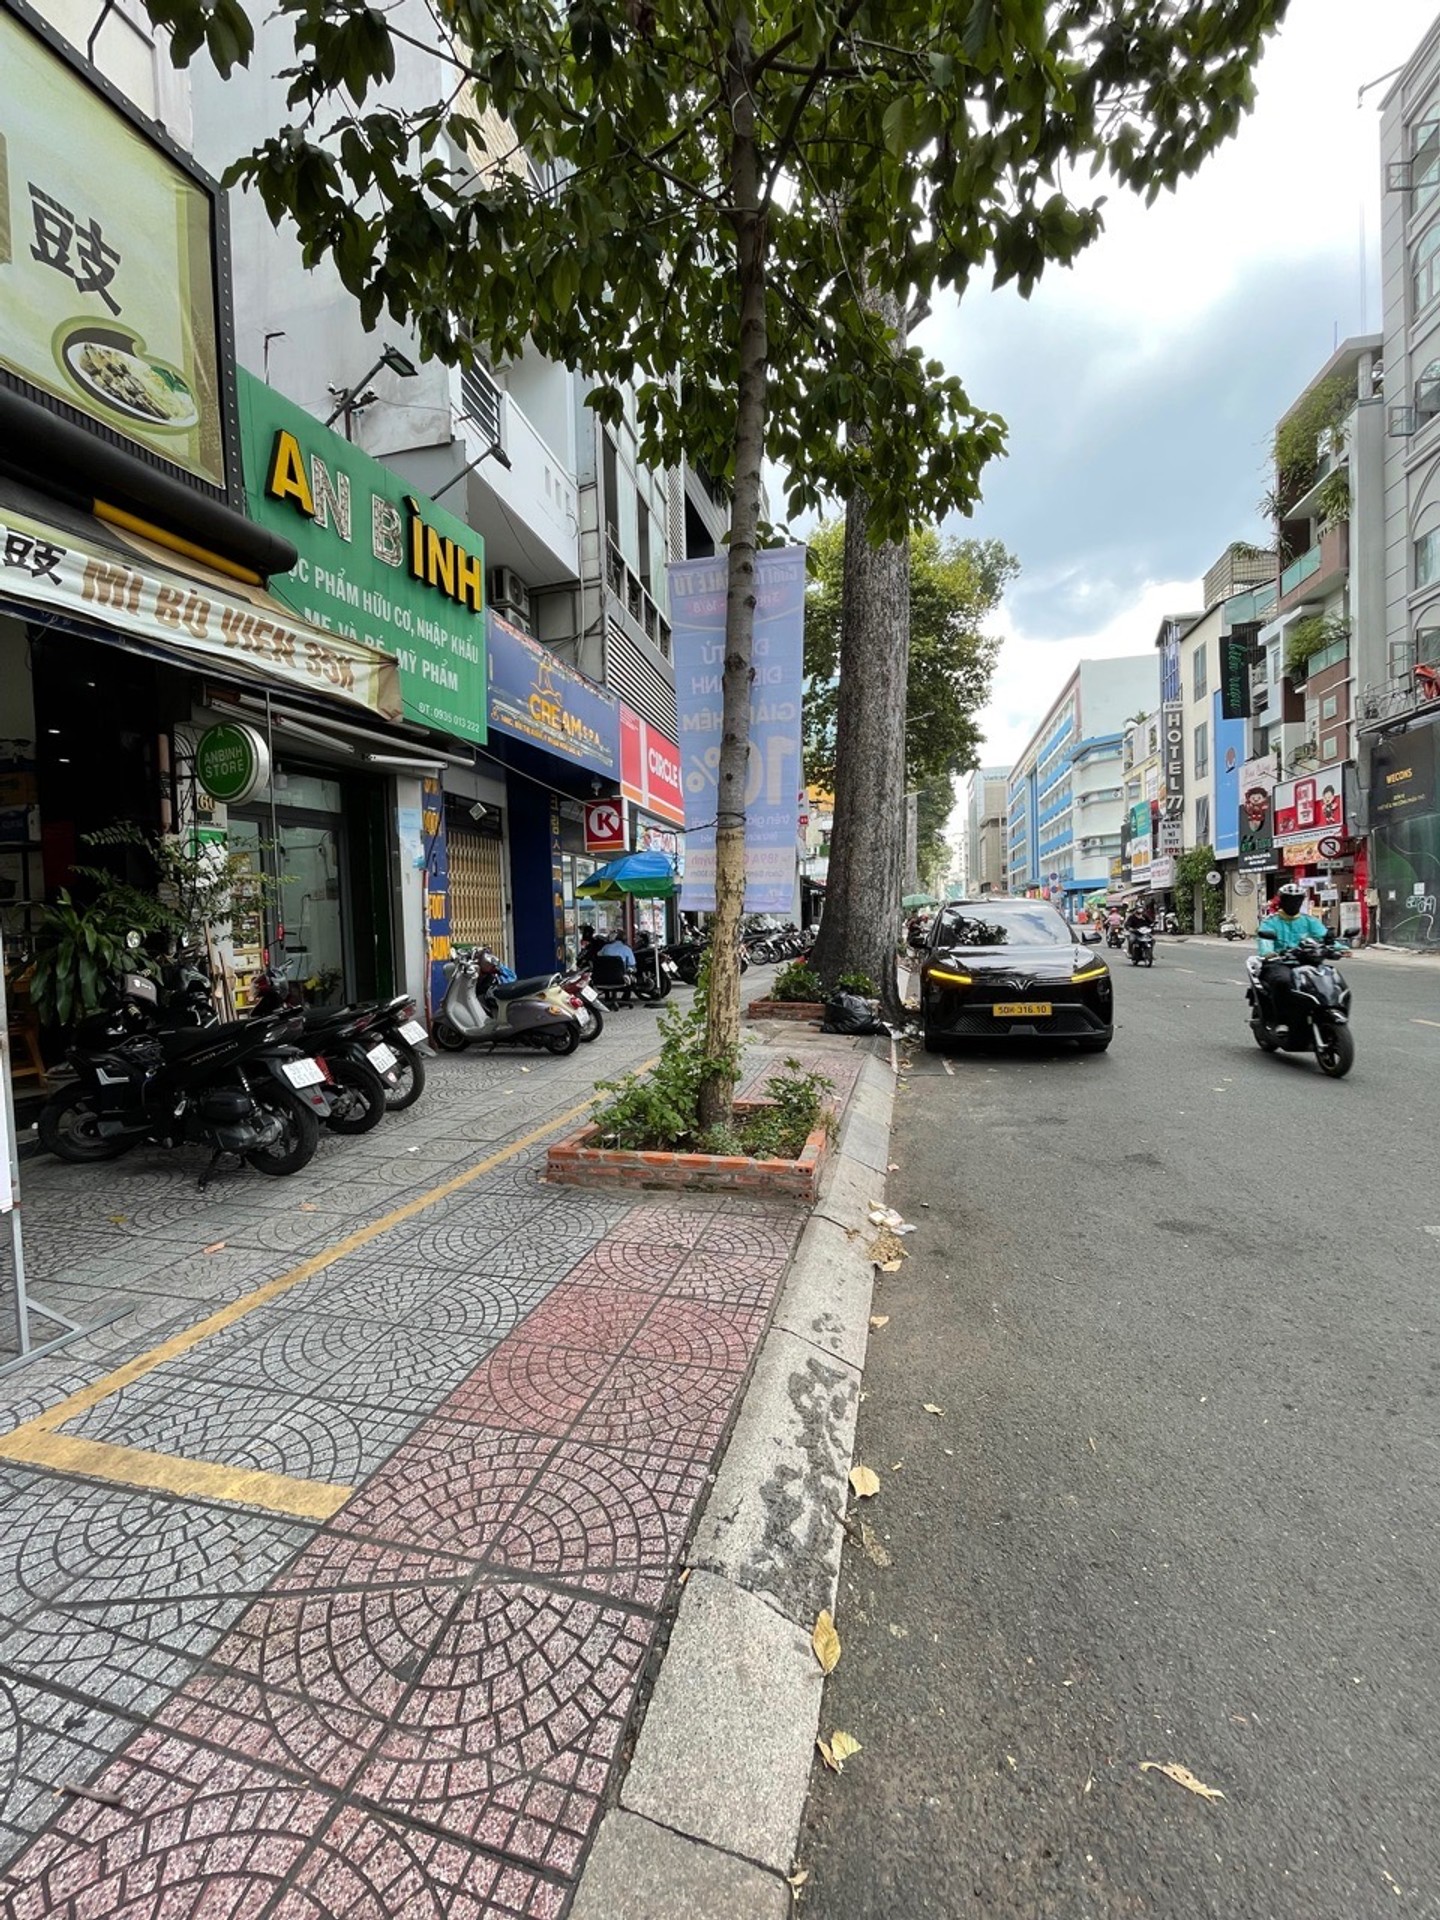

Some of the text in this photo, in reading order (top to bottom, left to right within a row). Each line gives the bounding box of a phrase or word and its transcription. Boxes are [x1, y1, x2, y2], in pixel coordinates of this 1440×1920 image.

[266, 429, 481, 613] AN BÌNH
[528, 693, 582, 740] CREAM
[205, 759, 245, 778] STORE
[648, 747, 678, 789] CIRCLE
[1167, 713, 1182, 790] HOTEL
[1167, 795, 1183, 809] 77
